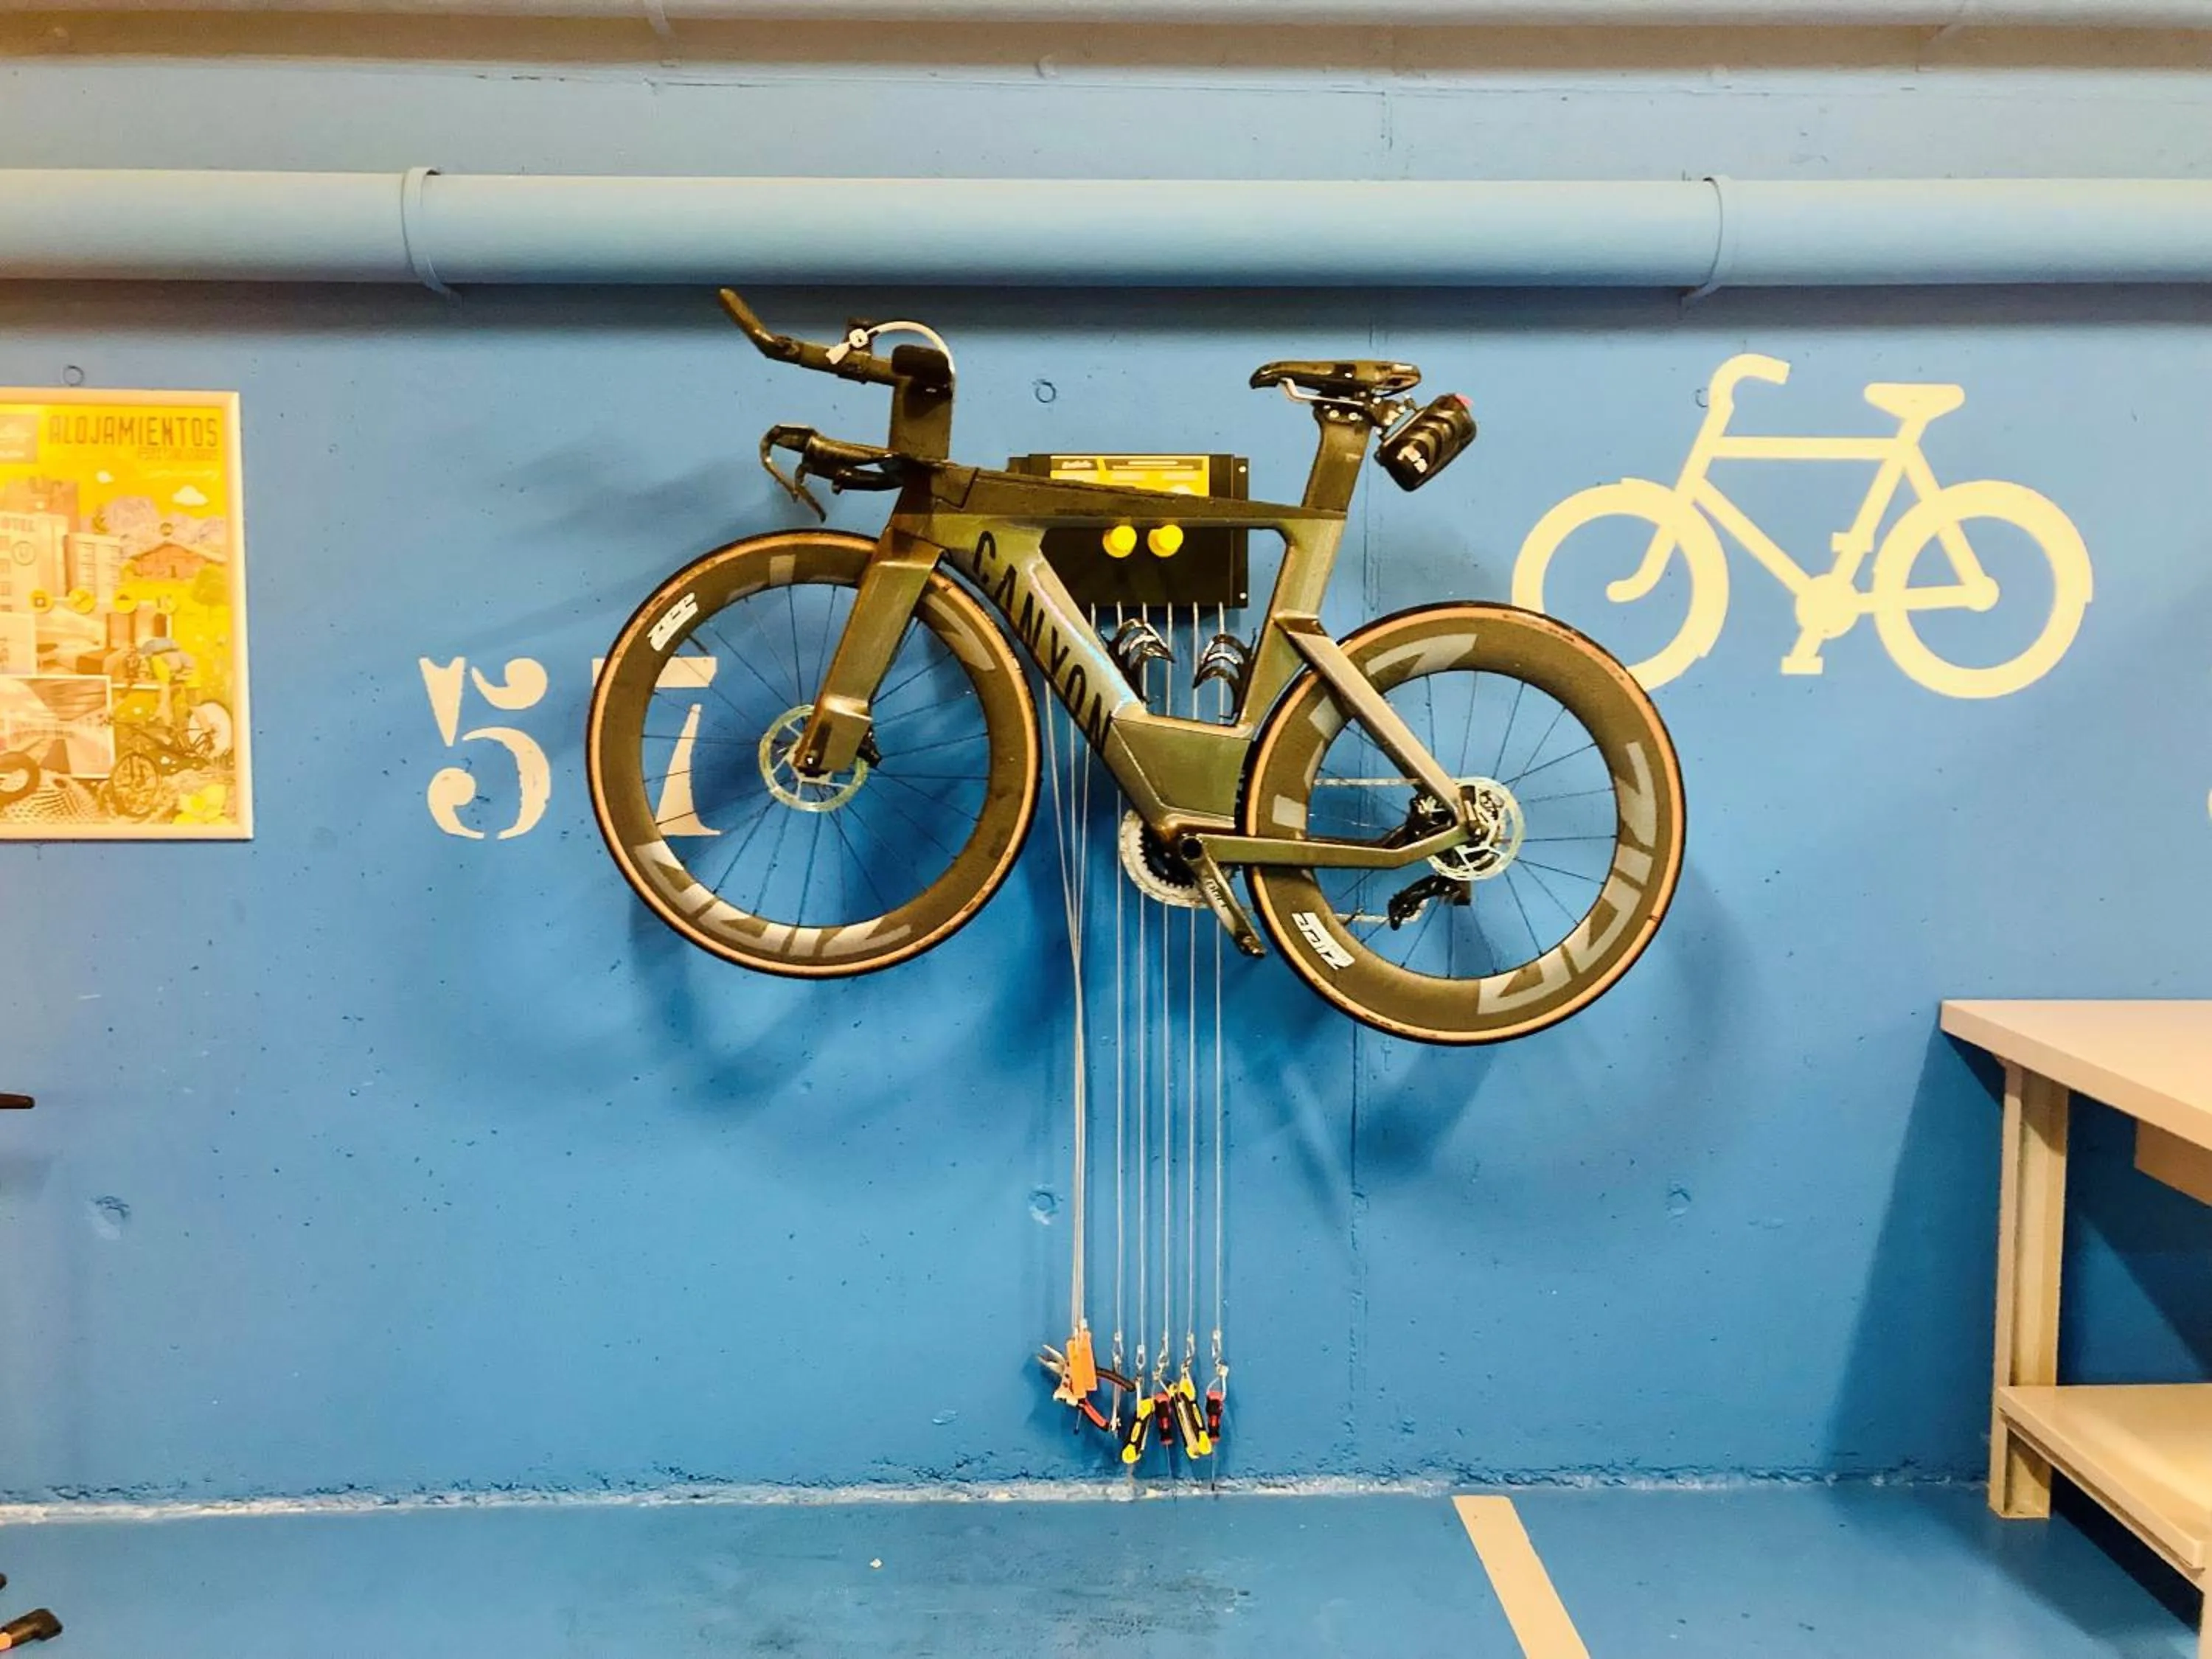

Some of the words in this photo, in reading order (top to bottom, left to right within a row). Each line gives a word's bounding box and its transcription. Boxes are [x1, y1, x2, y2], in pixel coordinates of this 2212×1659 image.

[48, 415, 218, 447] ALOJAMIENTOS
[972, 530, 1113, 751] CANYON
[419, 656, 722, 839] 57
